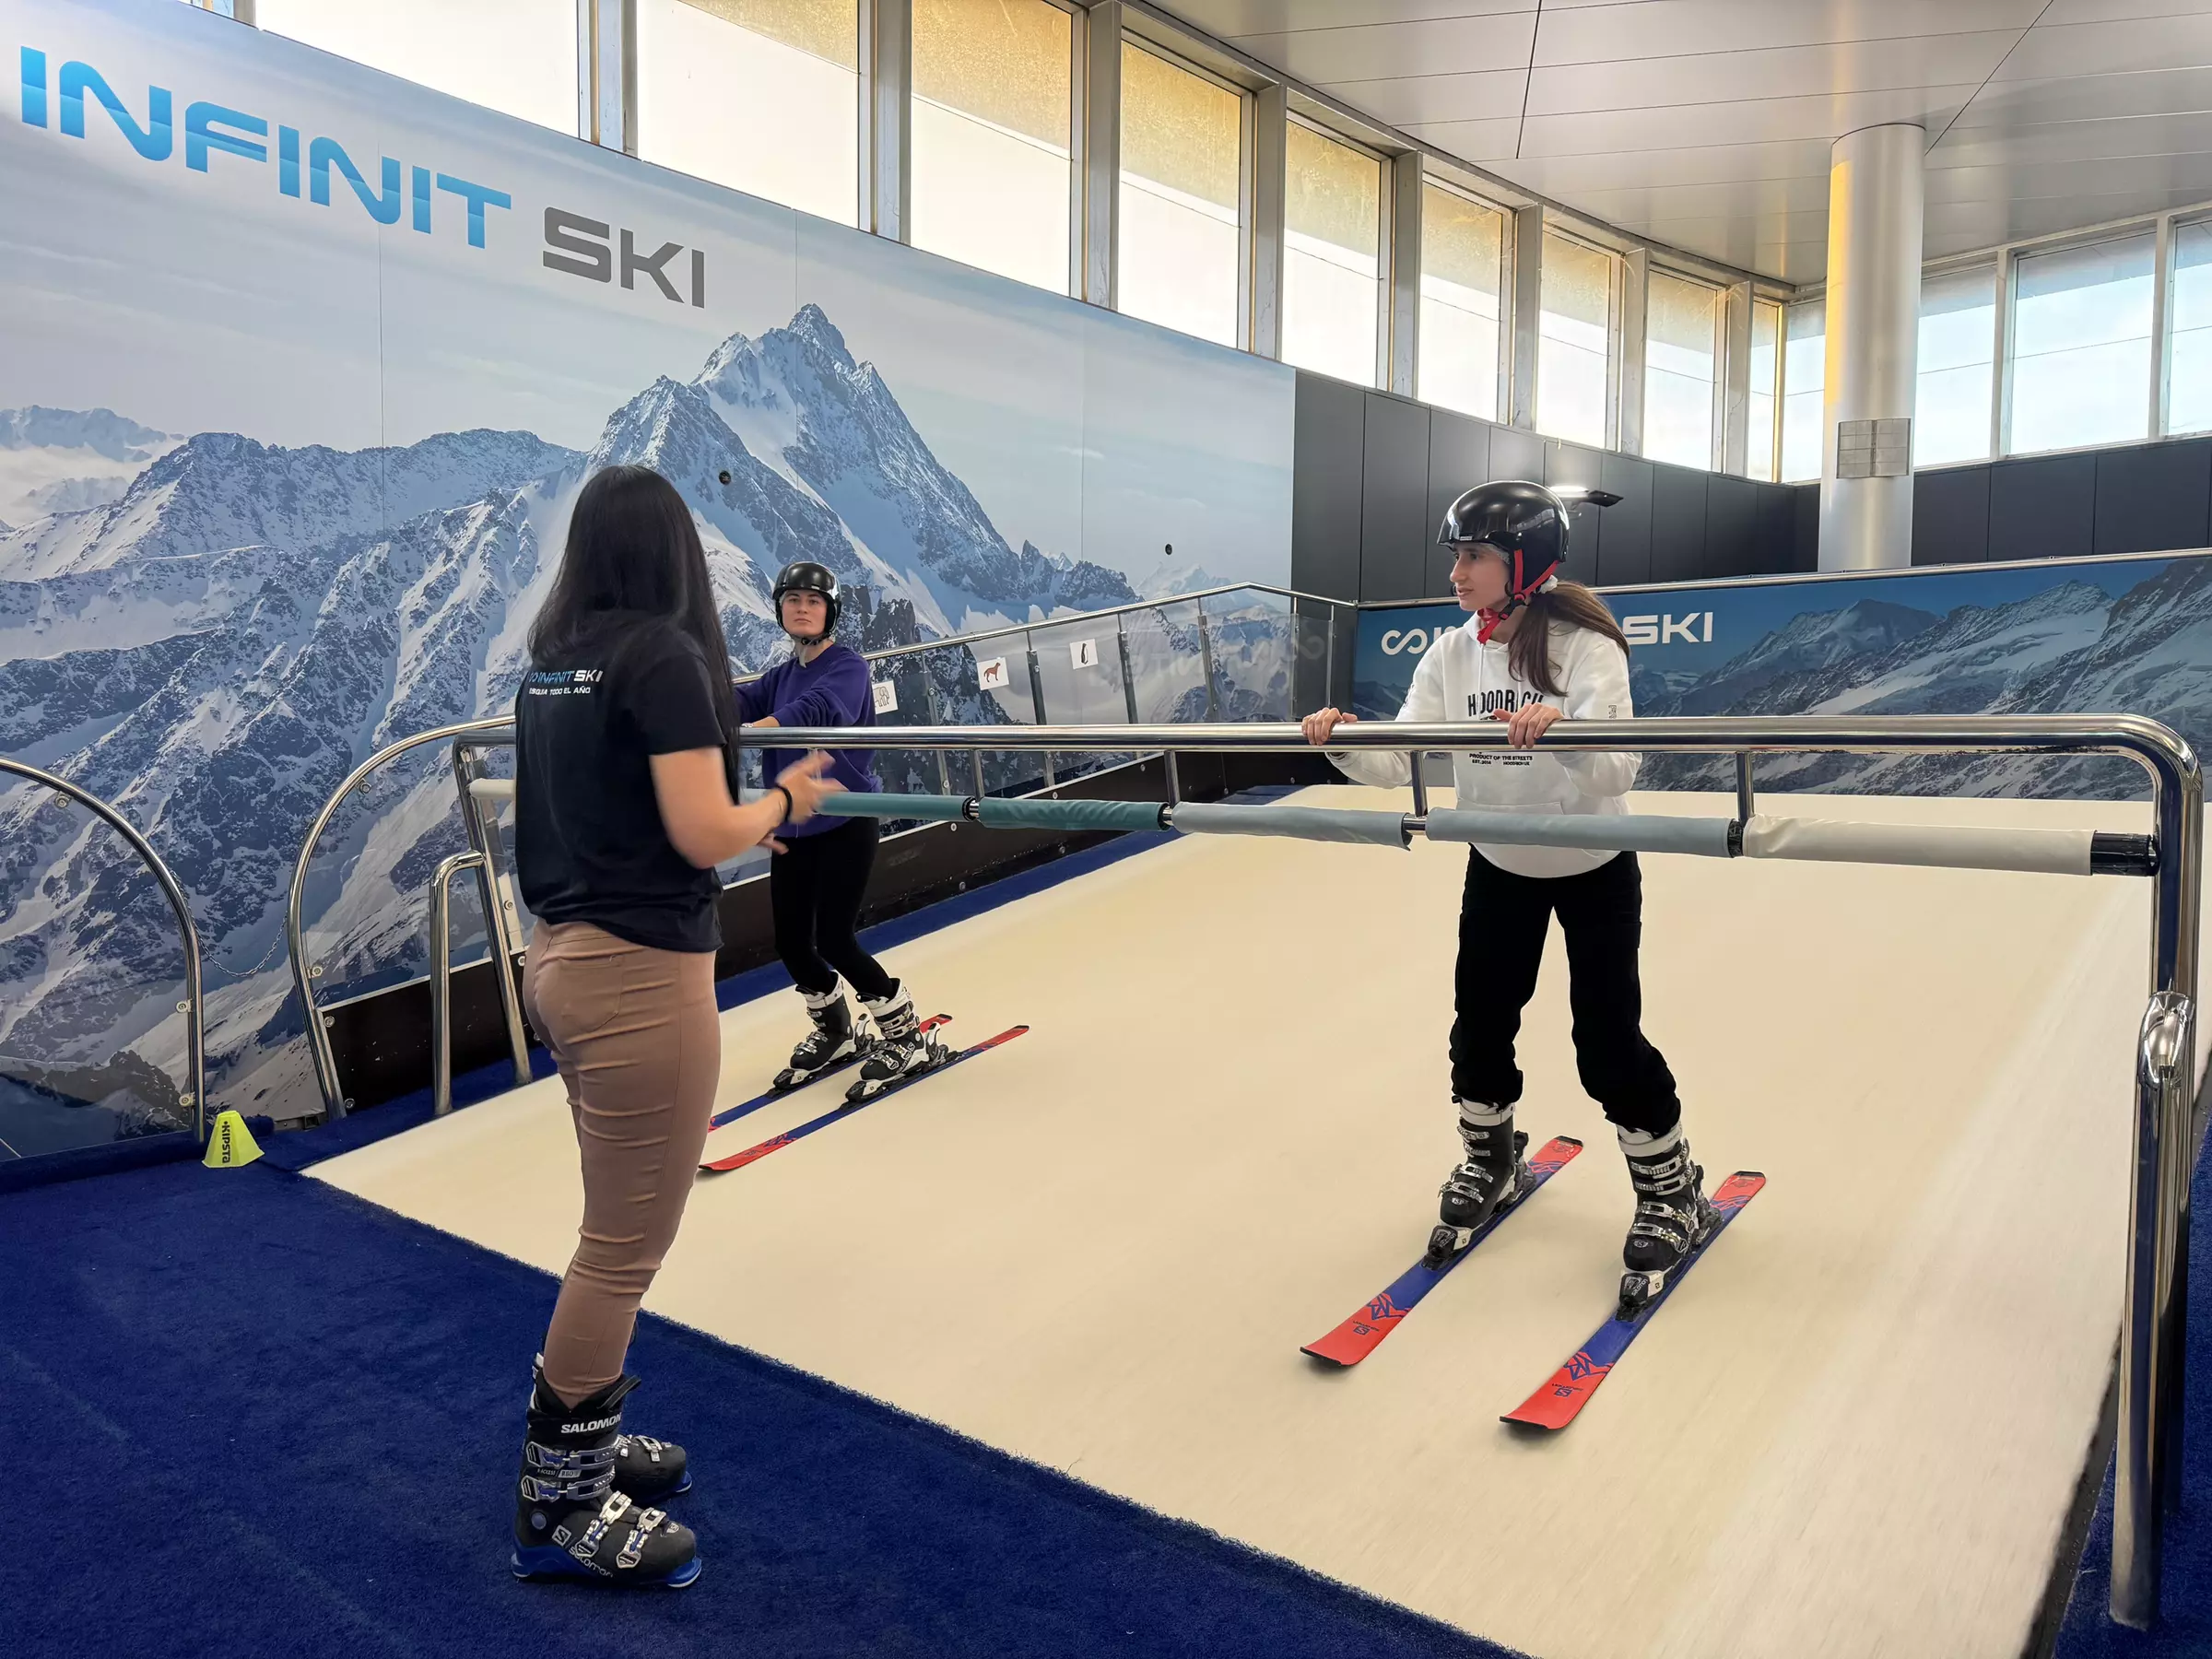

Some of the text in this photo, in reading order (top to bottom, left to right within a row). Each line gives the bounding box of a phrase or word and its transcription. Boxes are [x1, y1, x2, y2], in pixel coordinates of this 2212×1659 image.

[20, 45, 705, 309] INFINIT SKI
[1621, 611, 1714, 645] SKI
[573, 669, 604, 682] SKI
[572, 685, 591, 694] AÑO
[560, 1412, 622, 1434] SALOMON
